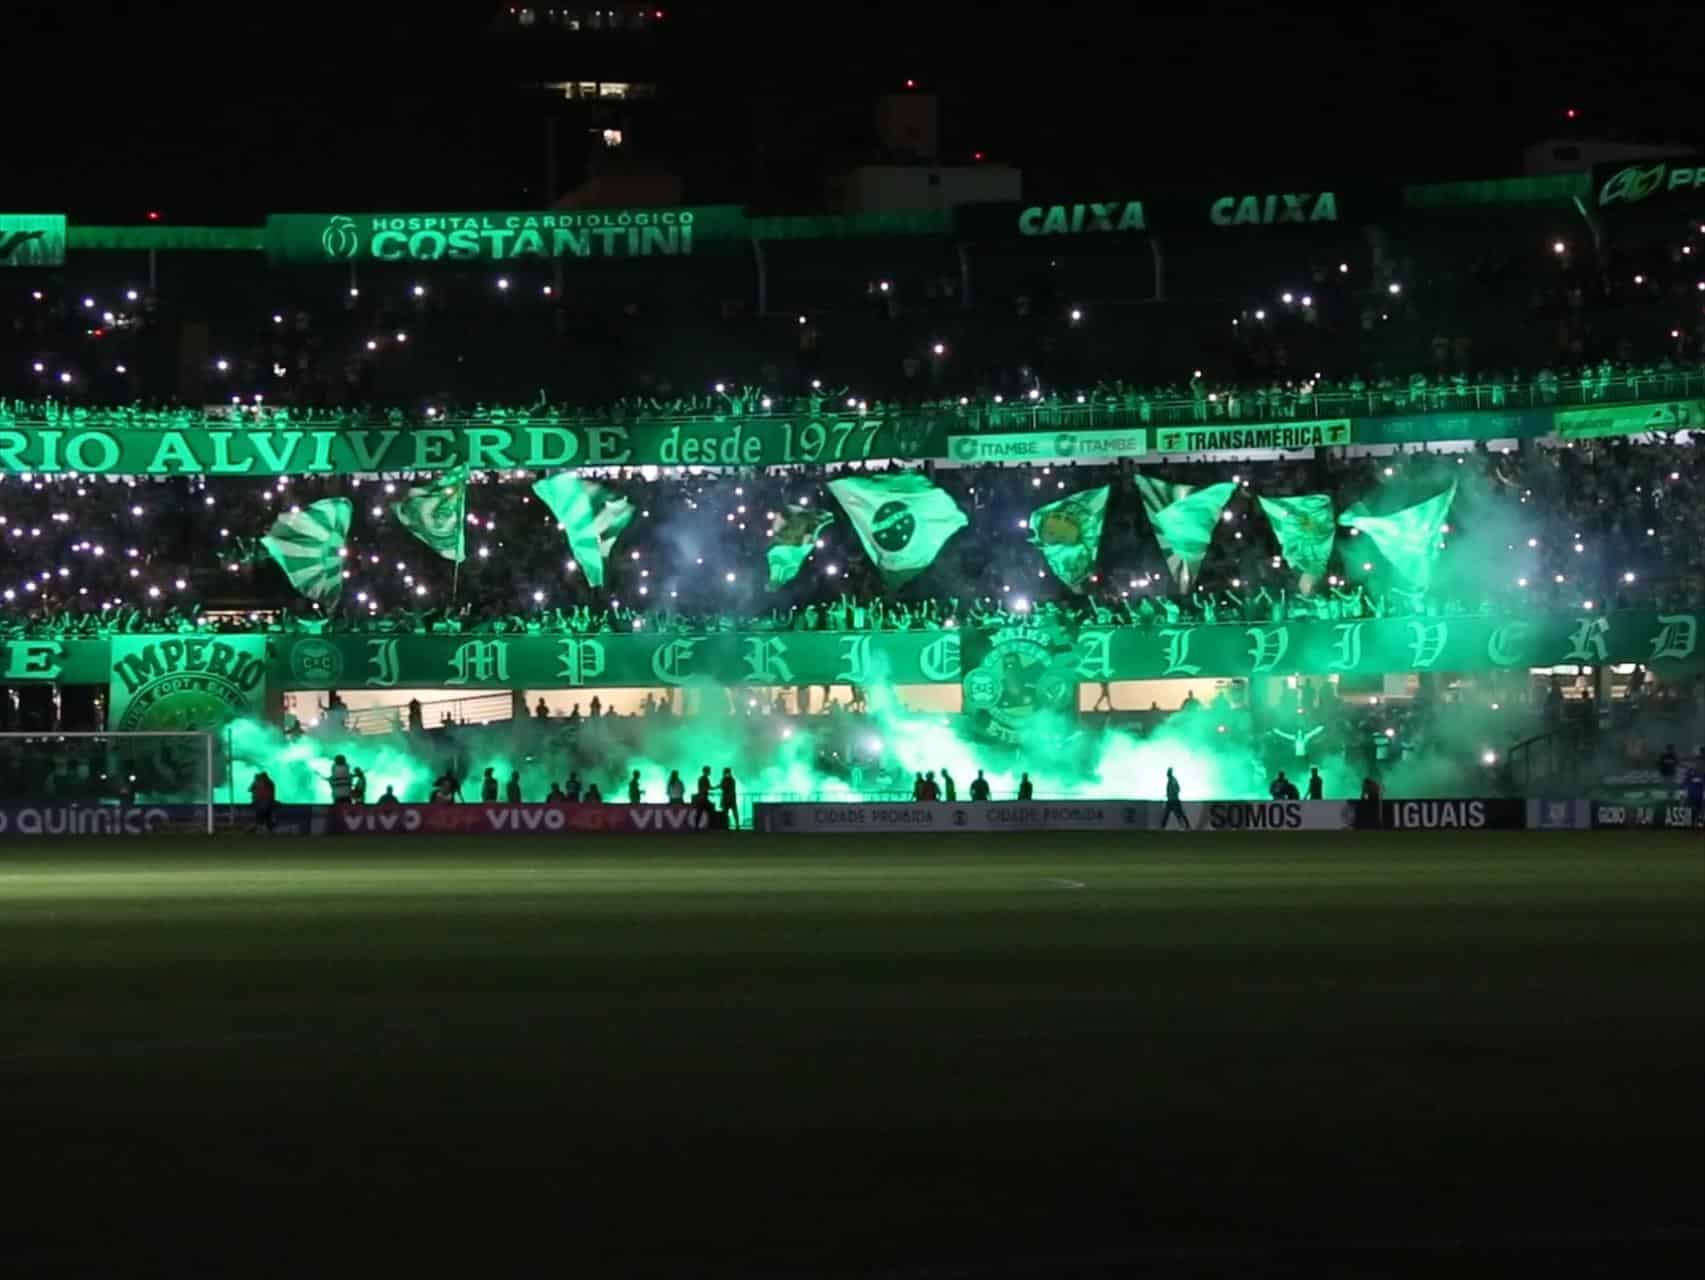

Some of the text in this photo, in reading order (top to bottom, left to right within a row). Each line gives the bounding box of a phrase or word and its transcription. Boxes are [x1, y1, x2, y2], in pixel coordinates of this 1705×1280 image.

[372, 210, 694, 231] HOSPITAL CARDIOLÓGICO
[1018, 201, 1146, 236] CAIXA
[1210, 192, 1337, 226] CAIXA
[371, 225, 693, 260] COSTANTINI
[147, 425, 631, 472] ALVIVERDE
[659, 425, 762, 465] desde
[784, 420, 883, 462] 1977
[1210, 803, 1301, 828] SOMOS
[1393, 801, 1486, 828] IGUAIS
